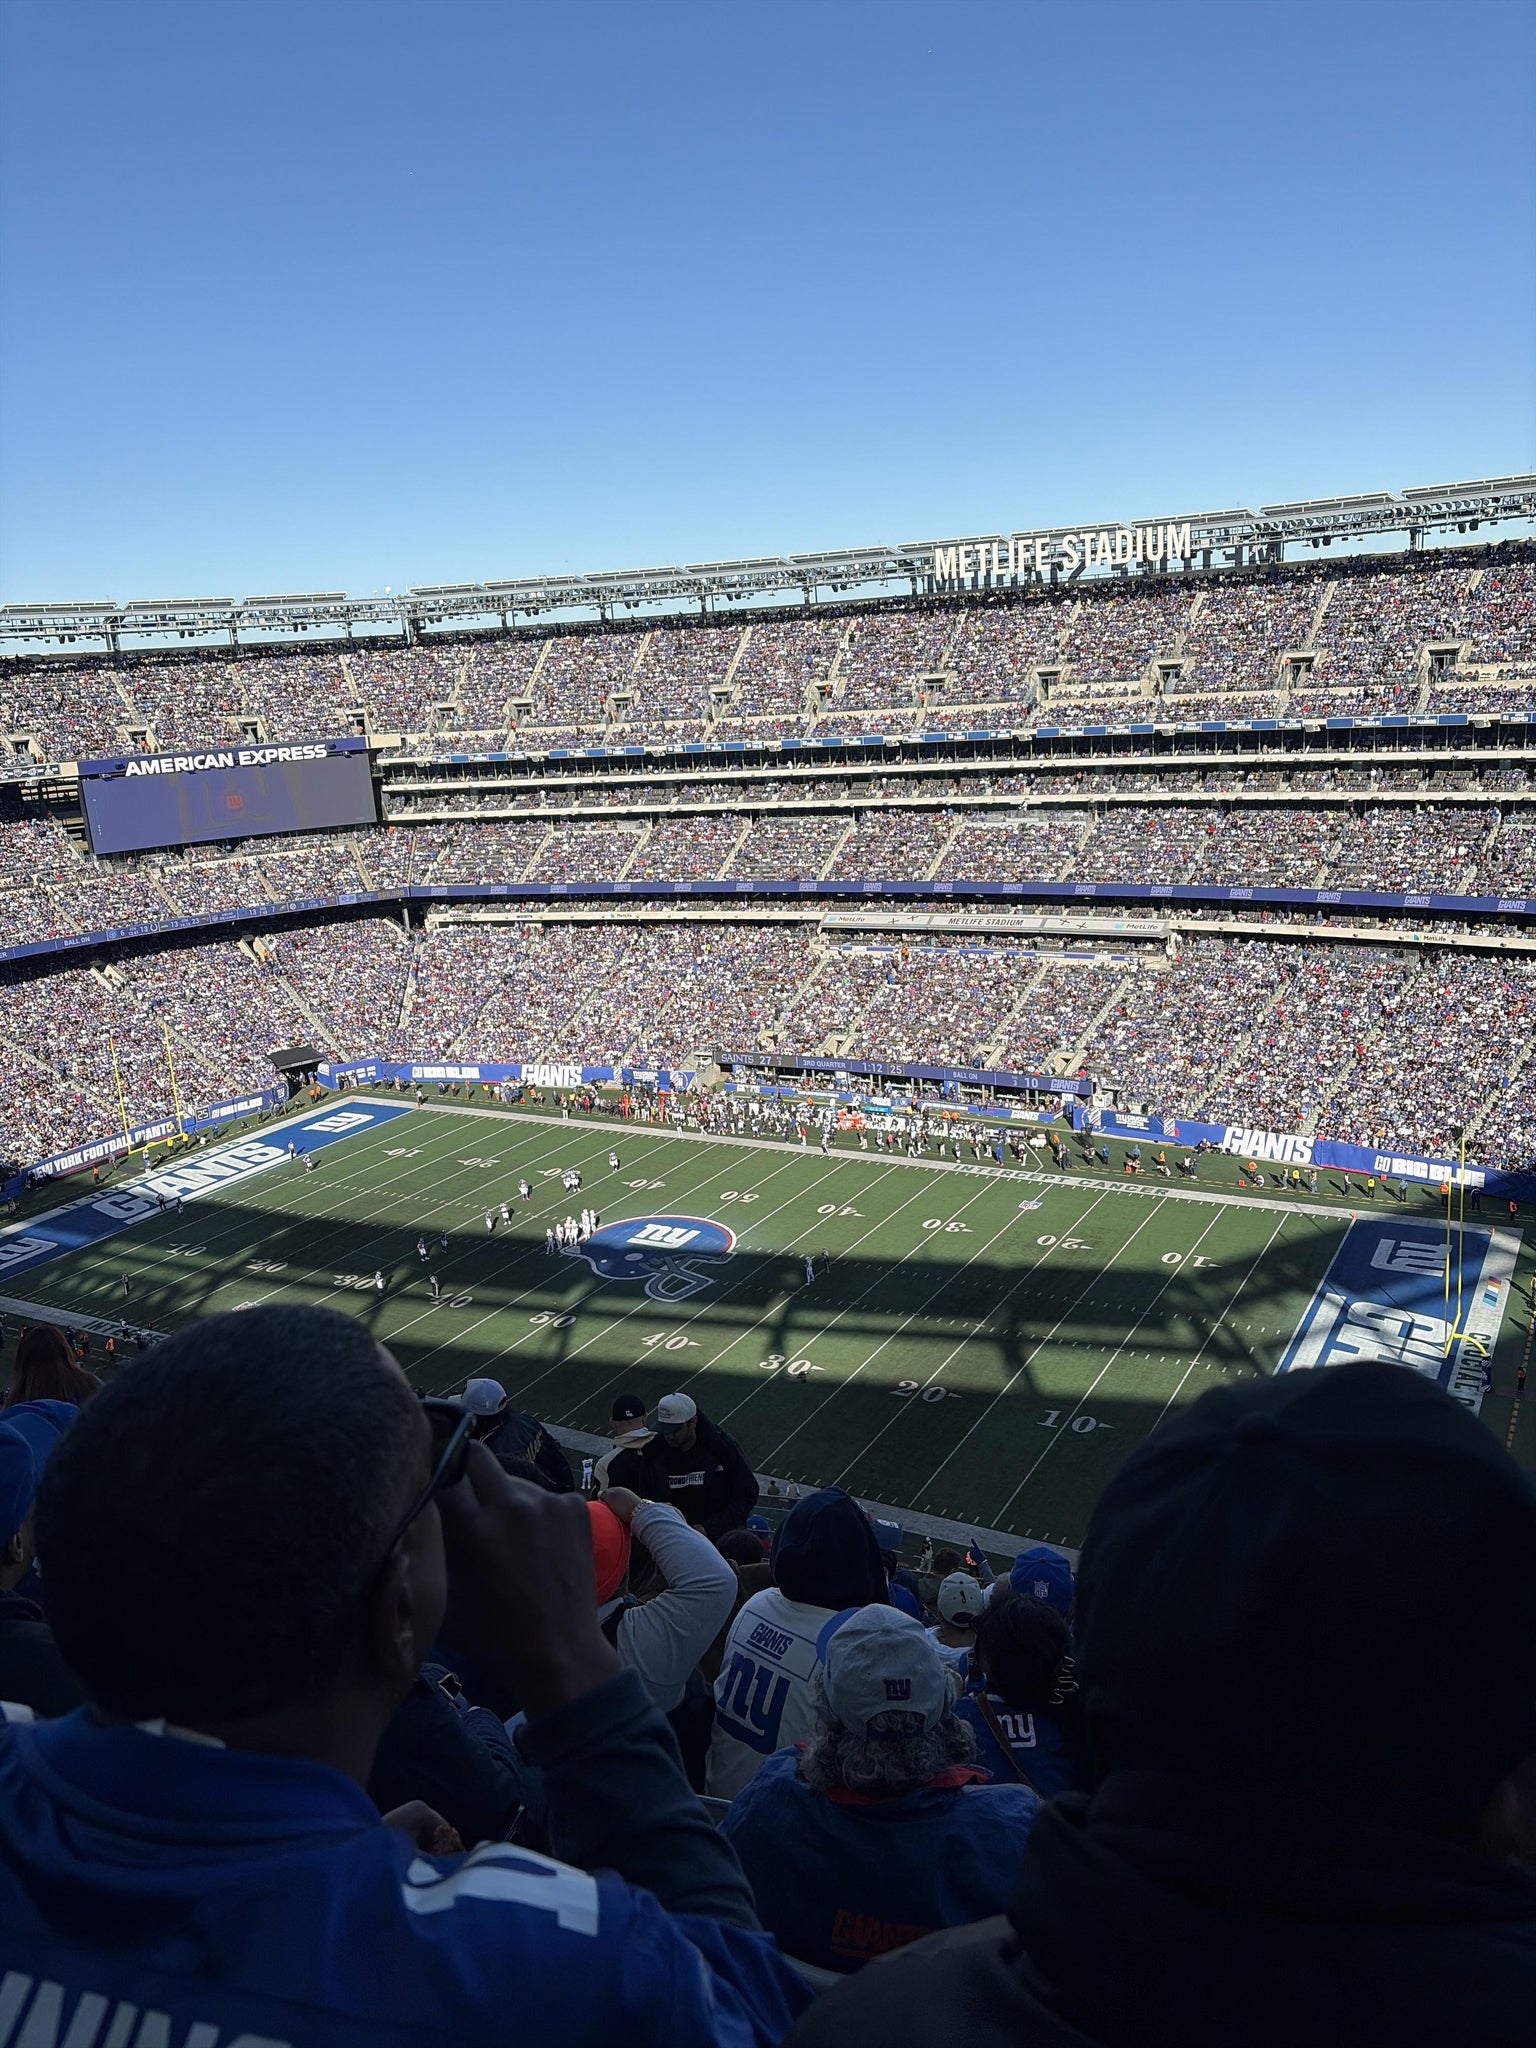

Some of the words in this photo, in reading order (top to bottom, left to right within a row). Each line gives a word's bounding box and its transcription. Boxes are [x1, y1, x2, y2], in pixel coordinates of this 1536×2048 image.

[935, 538, 1051, 581] METLIFE
[1062, 523, 1191, 570] STADIUM
[125, 752, 234, 777] AMERICAN
[239, 744, 327, 766] EXPRESS
[933, 883, 953, 891] GIANTS
[1002, 884, 1023, 892] GIANTS
[1075, 885, 1096, 893] GIANTS
[1151, 886, 1173, 895] GIANTS
[1229, 888, 1253, 897] GIANTS
[1317, 891, 1341, 901] GIANTS
[1404, 895, 1430, 905] GIANTS
[1498, 899, 1526, 910] GIANTS
[985, 918, 1023, 926] STADIUM
[1126, 923, 1158, 931] MetLife
[64, 938, 79, 946] BALL
[521, 1065, 582, 1087] GIANTS
[721, 1053, 754, 1064] SAINTS
[759, 1055, 771, 1065] 27
[802, 1059, 815, 1067] 3RD
[816, 1060, 846, 1069] QUARTER
[862, 1063, 883, 1073] 1:12
[890, 1065, 902, 1074] 25
[952, 1071, 966, 1079] BALL
[1024, 1078, 1038, 1088] 10
[1050, 1079, 1080, 1091] GIANTS
[197, 1109, 208, 1120] 25
[1010, 1109, 1040, 1121] GIANTS
[1223, 1126, 1315, 1164] GIANTS
[54, 1156, 83, 1174] YORK
[83, 1136, 134, 1162] FOOTBALL
[1374, 1154, 1391, 1171] GO
[1391, 1158, 1431, 1179] BIG
[1433, 1163, 1486, 1188] BLUE
[92, 1143, 285, 1220] GIANTS
[953, 1164, 1071, 1183] INTERCEPT
[1078, 1179, 1170, 1196] CANCER
[720, 1190, 759, 1203] 50
[817, 1204, 857, 1217] 40
[922, 1218, 966, 1233] 30
[1037, 1234, 1085, 1250] 20
[166, 1243, 207, 1257] 10
[246, 1258, 288, 1273] 20
[1161, 1252, 1212, 1268] 10
[333, 1274, 376, 1290] 30
[529, 1311, 577, 1328] 50
[640, 1333, 691, 1350] 40
[759, 1354, 811, 1375] 30
[889, 1380, 948, 1403] 20
[1036, 1409, 1097, 1433] 10
[750, 1622, 794, 1656] GIANTS
